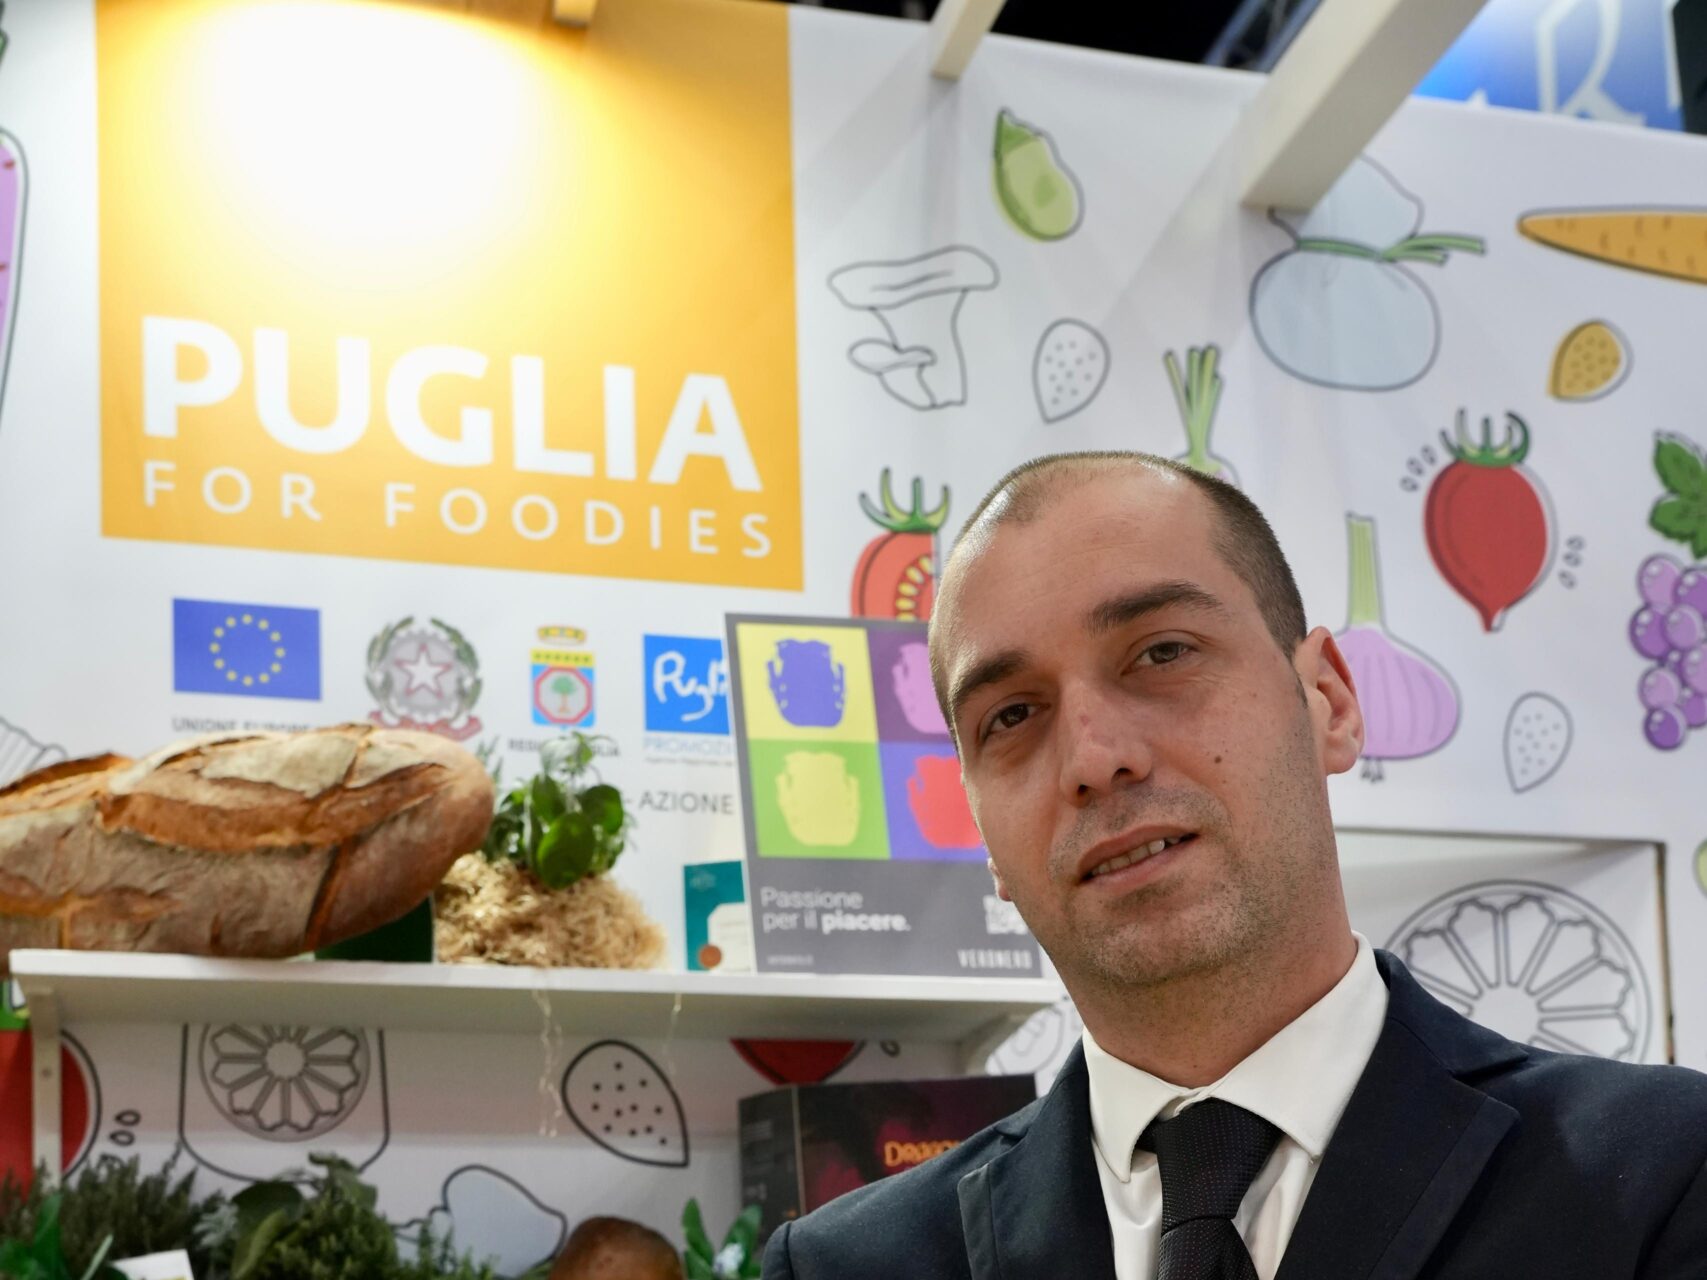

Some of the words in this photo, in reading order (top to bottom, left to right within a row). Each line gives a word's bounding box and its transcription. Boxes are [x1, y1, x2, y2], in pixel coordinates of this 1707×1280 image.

[142, 316, 763, 492] PUGLIA
[144, 461, 322, 522] FOR
[384, 482, 773, 559] FOODIES
[639, 790, 735, 815] AZIONE
[760, 886, 864, 910] Passione
[763, 912, 800, 934] per
[804, 909, 818, 930] il
